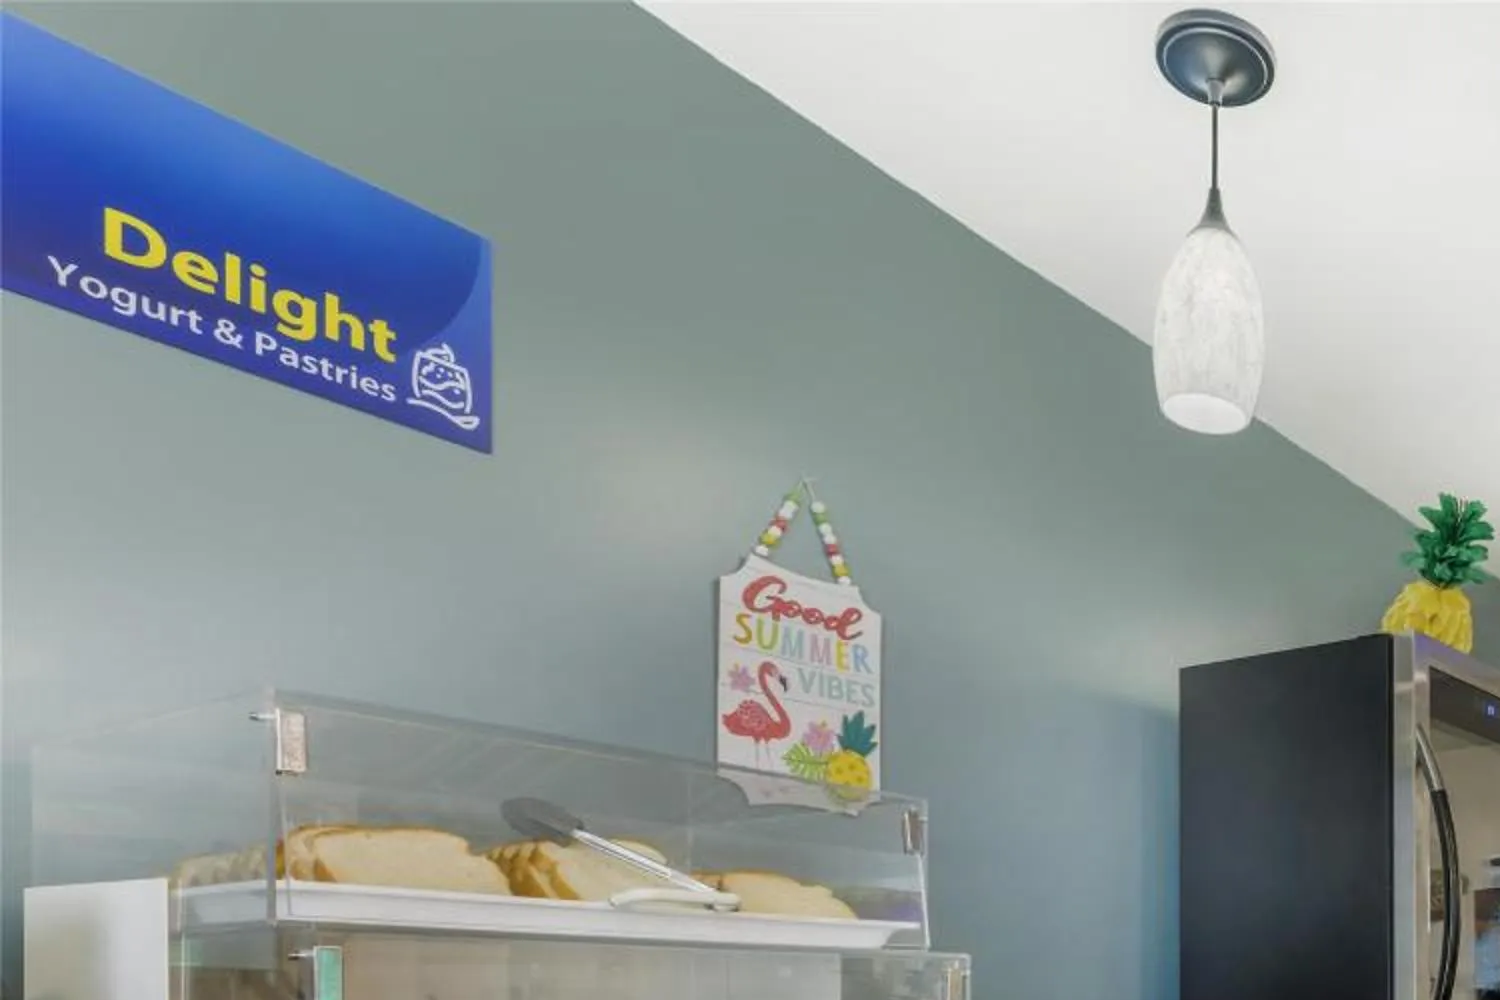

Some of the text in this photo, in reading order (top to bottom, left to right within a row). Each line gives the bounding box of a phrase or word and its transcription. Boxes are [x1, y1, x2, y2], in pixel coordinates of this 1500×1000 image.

[104, 206, 397, 363] Delight
[47, 255, 397, 403] Yogurt & Pastries
[742, 575, 864, 640] Good
[733, 613, 873, 674] SUMMER
[797, 667, 875, 708] VIBES
